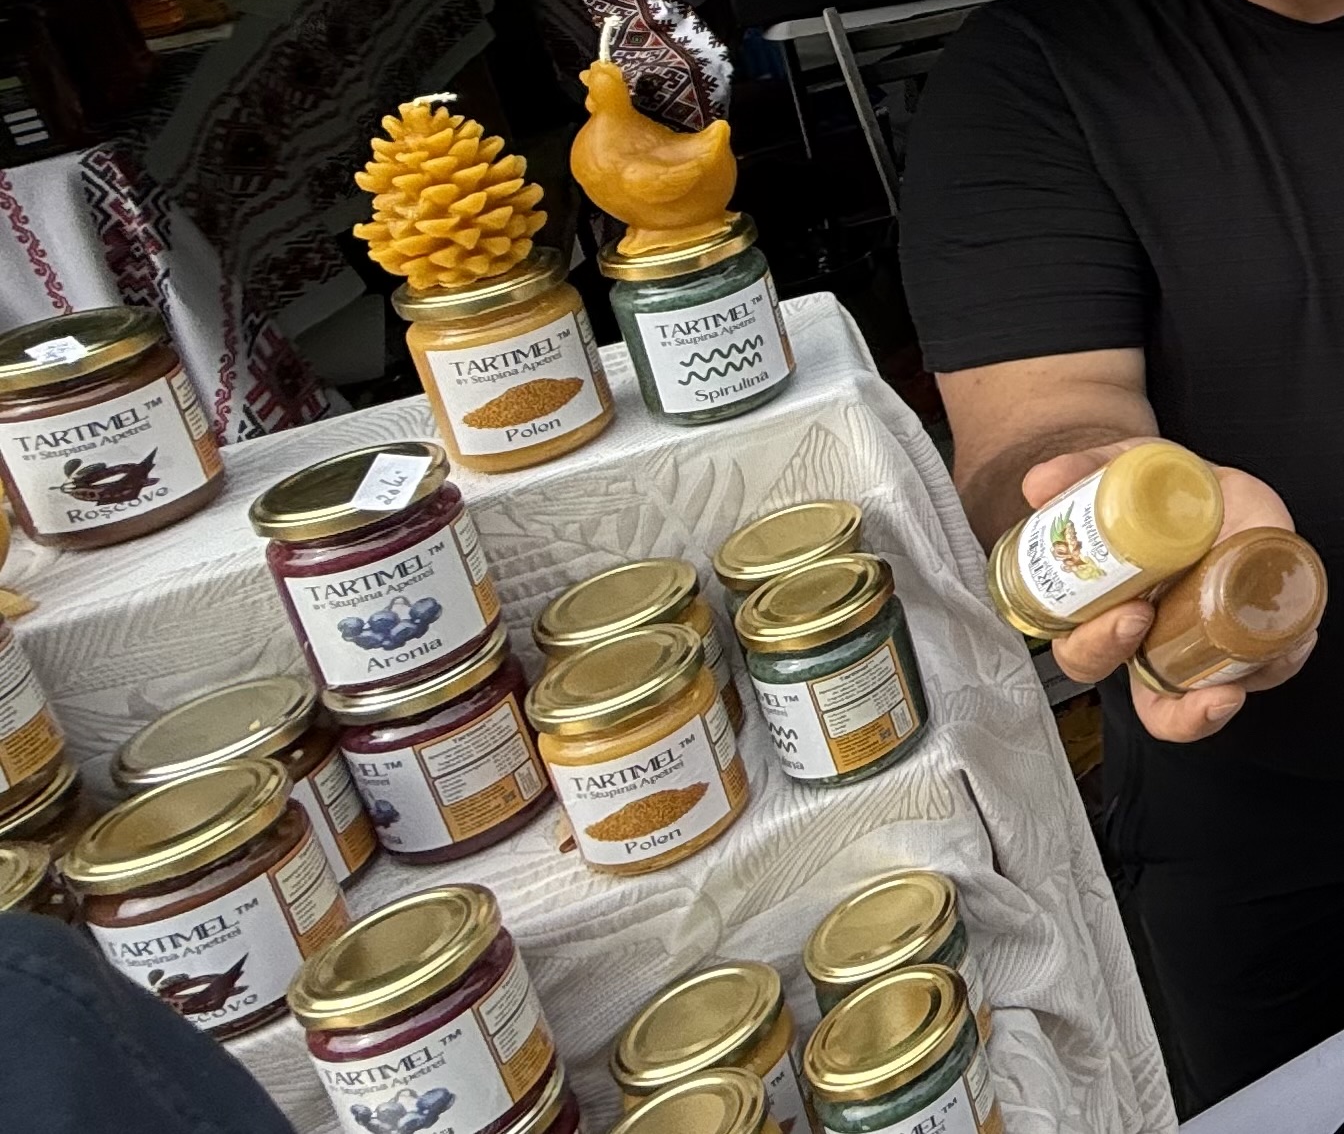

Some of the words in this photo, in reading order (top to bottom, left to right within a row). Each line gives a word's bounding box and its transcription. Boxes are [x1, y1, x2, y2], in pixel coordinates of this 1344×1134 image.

[694, 369, 771, 404] Spirulina
[366, 636, 443, 674] Aronia
[624, 827, 683, 856] Polen
